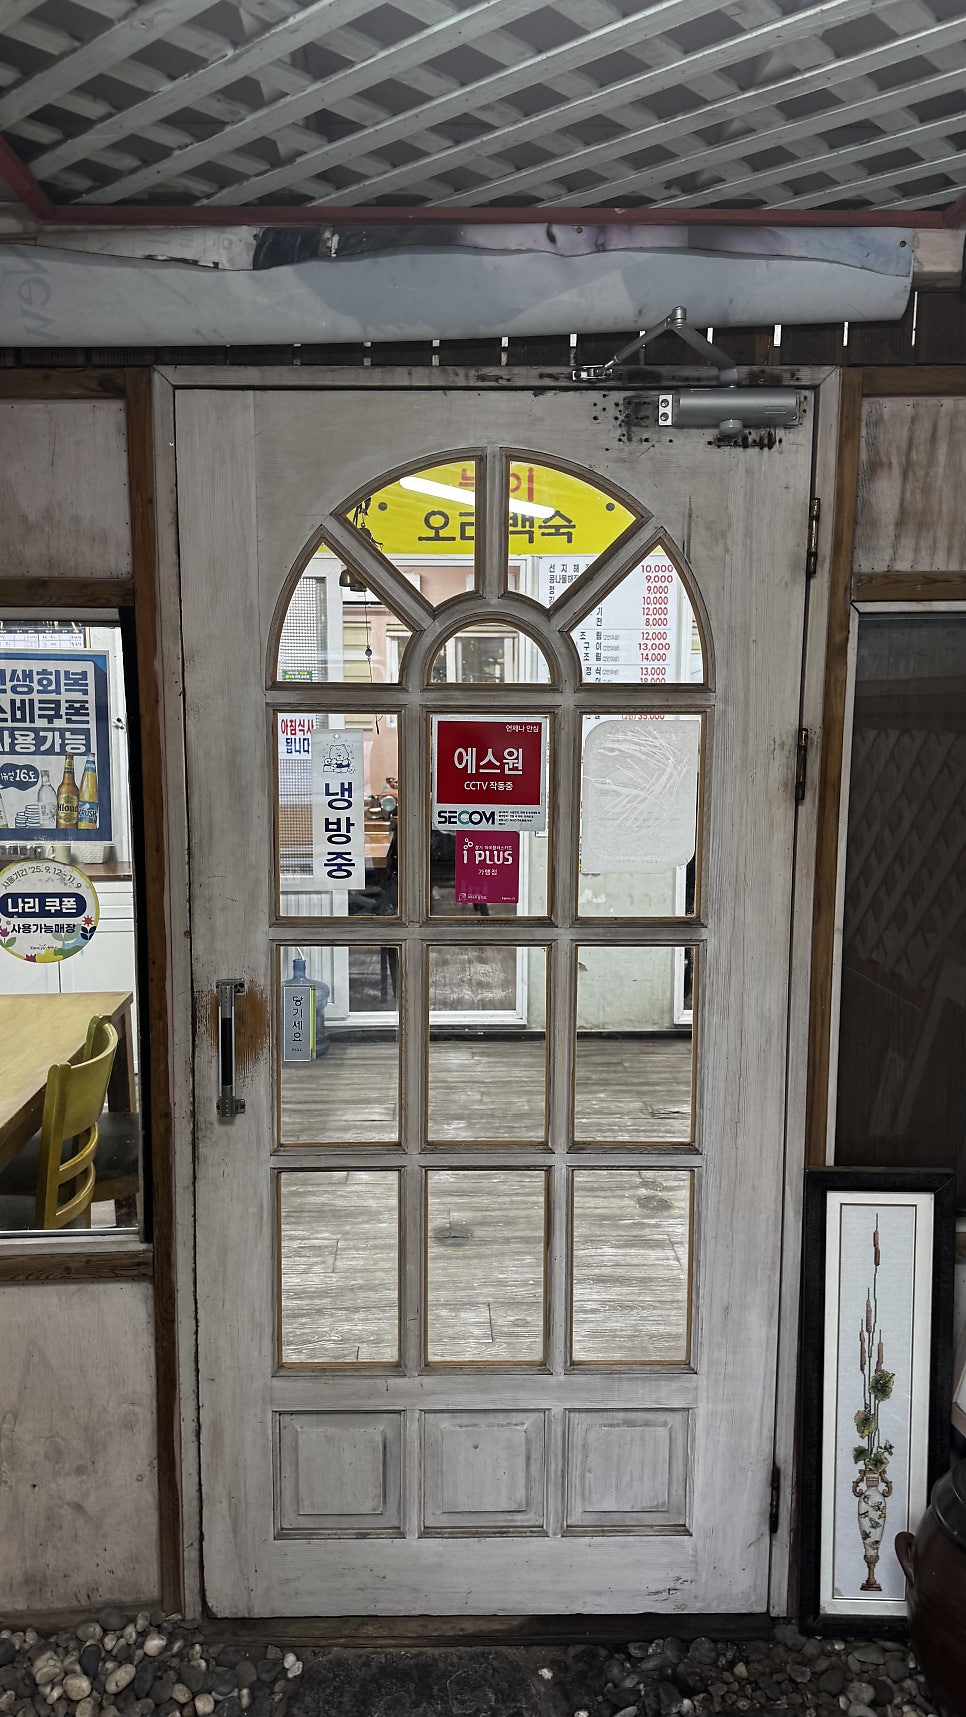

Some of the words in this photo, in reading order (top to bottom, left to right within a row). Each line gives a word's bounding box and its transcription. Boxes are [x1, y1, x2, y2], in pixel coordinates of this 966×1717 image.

[641, 564, 673, 573] 10,000
[645, 575, 673, 584] 9,000
[647, 585, 669, 595] 9,000
[642, 596, 668, 606] 10,000
[642, 607, 668, 617] 12,000
[645, 618, 668, 627] 8,000
[641, 632, 667, 641] 12,000
[638, 643, 670, 651] 13,000
[641, 653, 667, 662] 14,000
[640, 667, 666, 676] 13,000
[280, 719, 314, 736] 아침식사
[454, 747, 522, 775] 에스원
[15, 769, 38, 782] 16도
[464, 781, 488, 790] CCTV
[489, 781, 513, 790] 작동중
[438, 810, 495, 825] SECOM
[324, 781, 355, 879] 냉방중
[475, 850, 513, 864] PLUS
[2, 868, 28, 889] 사용기간
[7, 898, 39, 913] 나리
[45, 897, 77, 913] 쿠폰
[11, 923, 76, 934] 사용가능매장
[292, 996, 304, 1042] 당기세요
